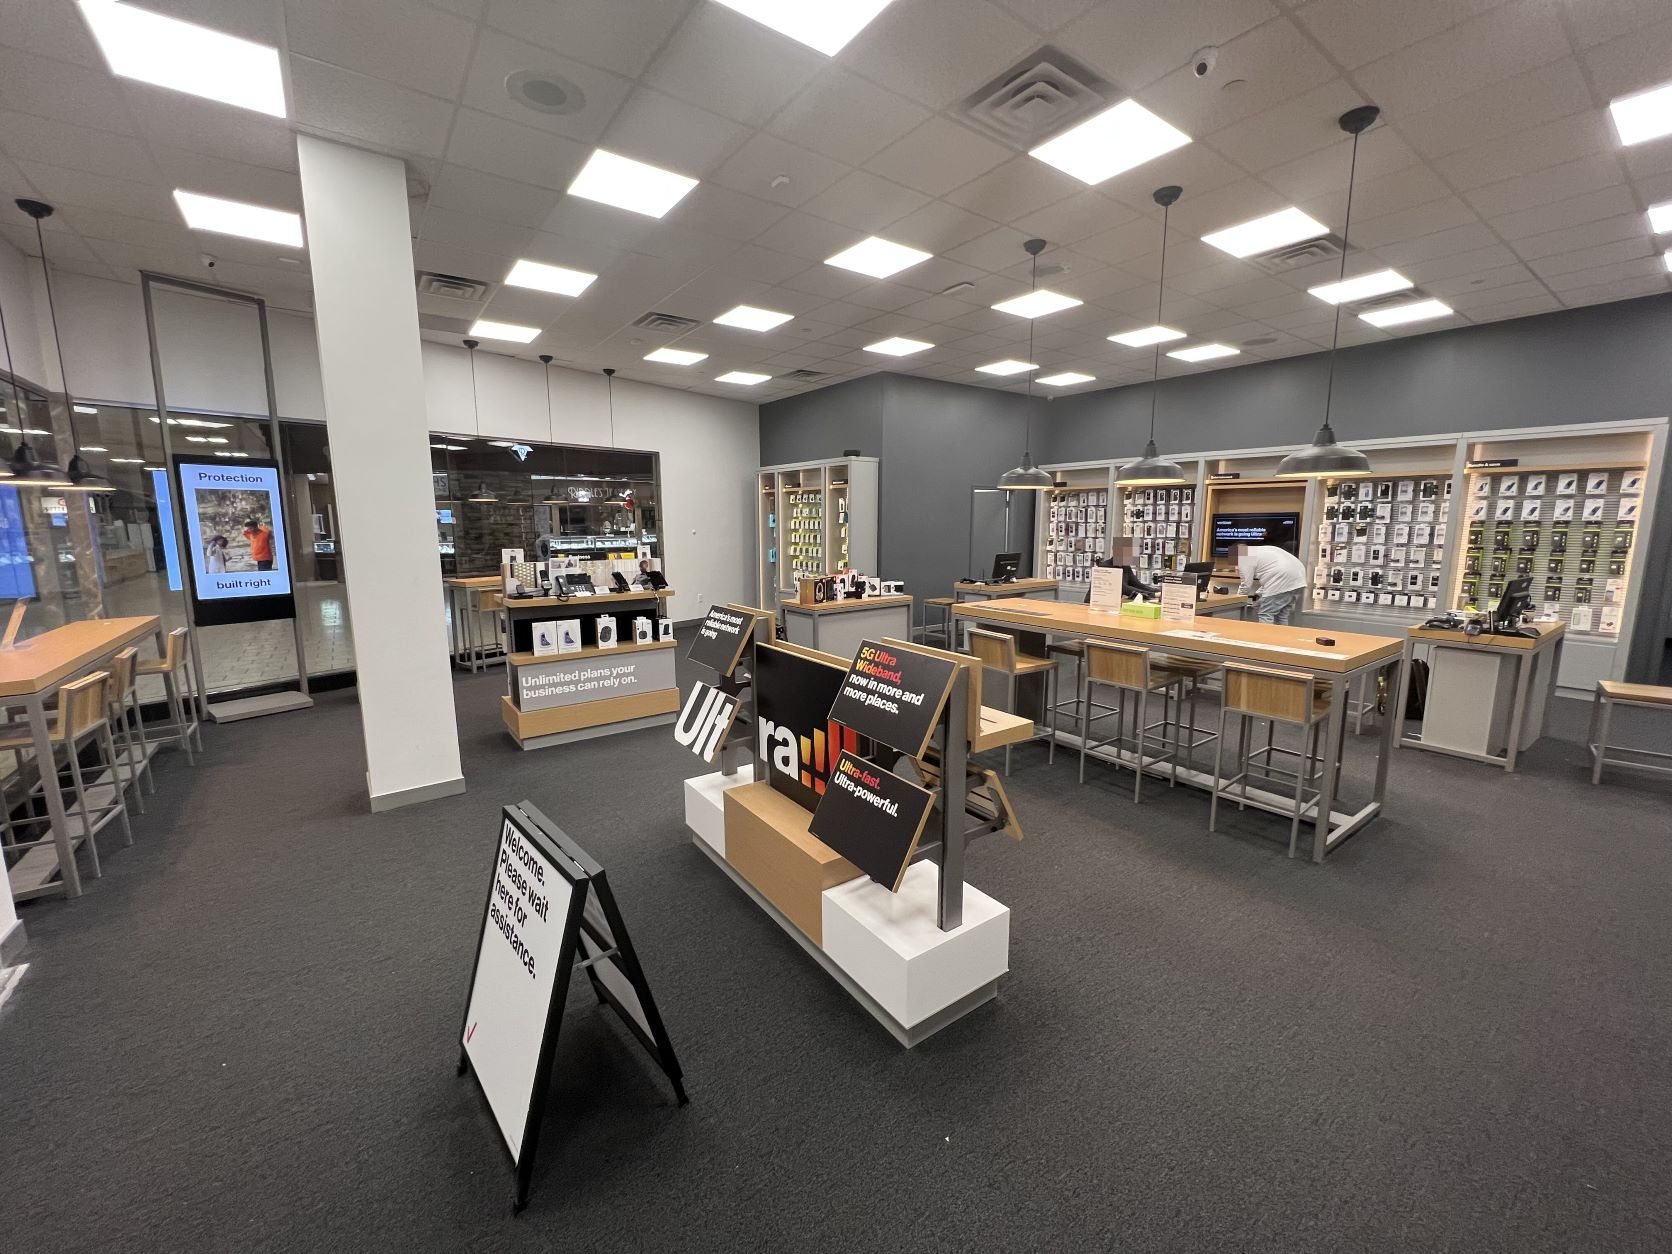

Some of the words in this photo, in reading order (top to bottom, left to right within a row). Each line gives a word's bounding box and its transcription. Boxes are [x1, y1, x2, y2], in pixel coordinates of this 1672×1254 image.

[198, 472, 263, 483] Protection
[216, 580, 243, 590] built
[245, 578, 272, 589] right
[860, 646, 876, 660] 5G
[874, 650, 897, 666] Ultra
[522, 670, 579, 687] Unlimited
[580, 668, 611, 681] plans
[611, 664, 636, 677] your
[523, 684, 576, 699] business
[577, 680, 598, 691] can
[599, 676, 620, 688] rely
[621, 675, 638, 684] on.
[855, 659, 902, 685] Wideband,
[843, 686, 867, 702] more
[865, 693, 899, 714] places.
[849, 673, 869, 687] now
[867, 677, 878, 690] in
[876, 683, 902, 699] more
[901, 691, 925, 706] and
[839, 758, 881, 790] Ultra-fast.
[834, 771, 899, 817] Ultra-powerful.
[504, 823, 545, 887] Welcome.
[494, 872, 514, 911] here
[513, 897, 528, 929] for
[499, 847, 528, 897] Please
[528, 885, 549, 924] wait
[490, 902, 536, 980] assistance.
